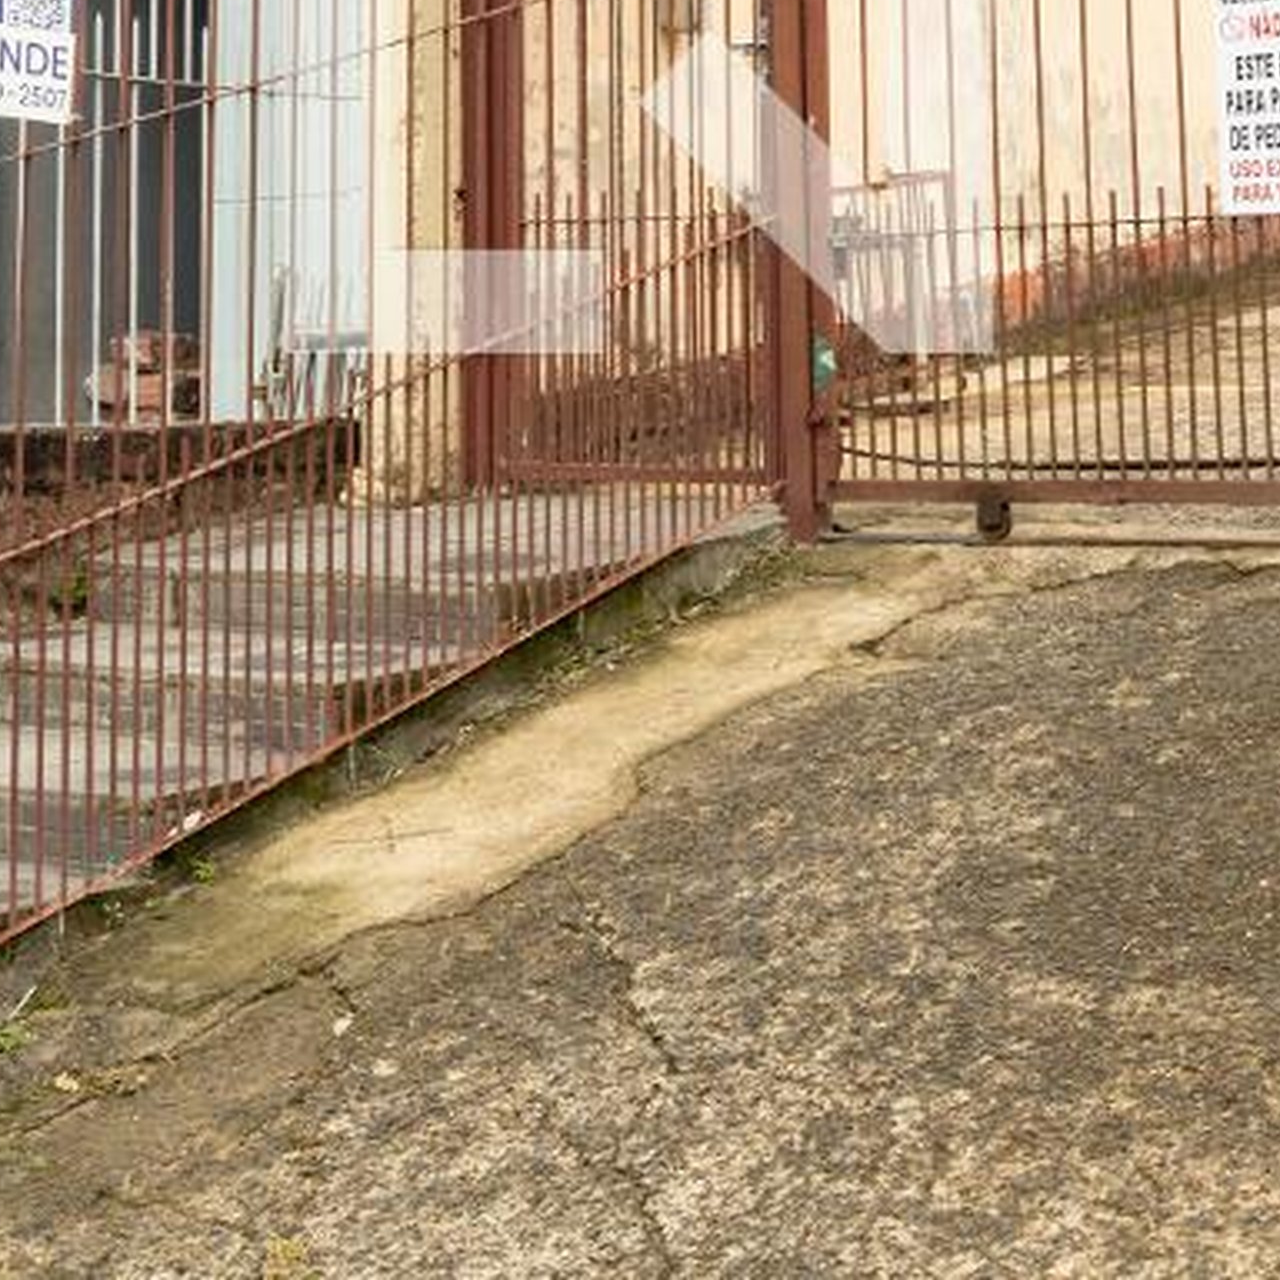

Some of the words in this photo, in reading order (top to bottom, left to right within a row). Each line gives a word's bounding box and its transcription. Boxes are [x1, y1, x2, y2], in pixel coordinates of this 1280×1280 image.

[1235, 52, 1274, 81] ESTE
[1226, 89, 1265, 116] PARA
[1230, 125, 1250, 151] DE
[1230, 159, 1263, 178] USO
[1233, 184, 1273, 203] PARA
